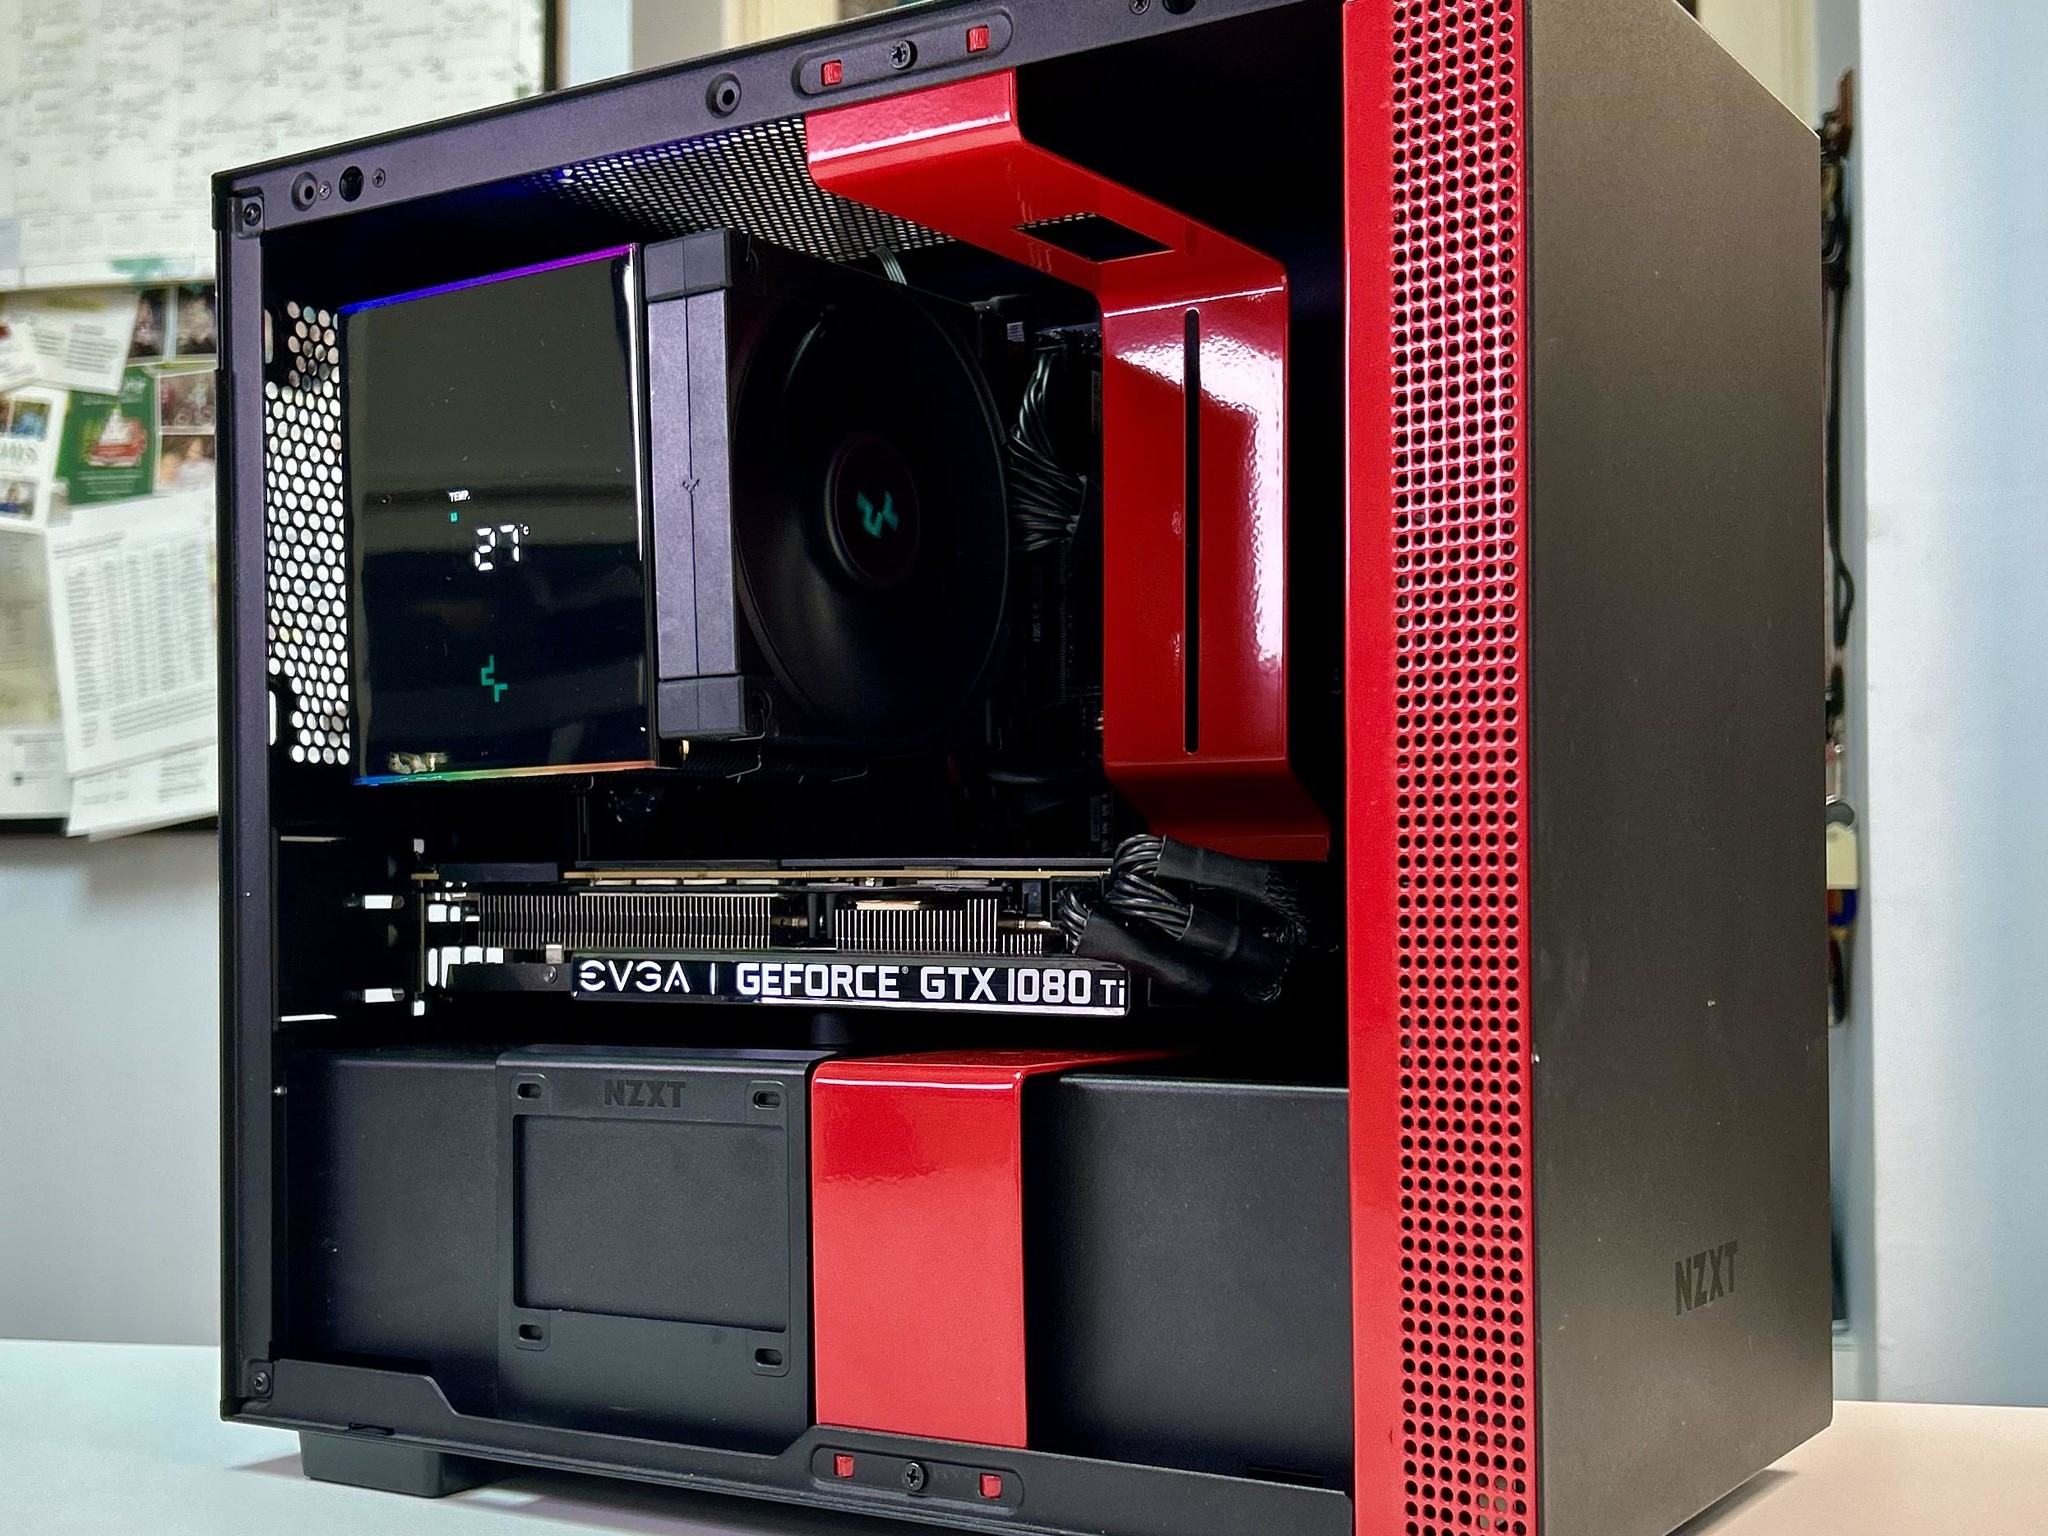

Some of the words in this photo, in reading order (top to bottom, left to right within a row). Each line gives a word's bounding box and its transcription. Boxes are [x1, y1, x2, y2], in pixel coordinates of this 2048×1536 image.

[579, 960, 690, 993] EVGA
[919, 966, 997, 1001] GTX
[1007, 968, 1092, 1004] 1080
[1099, 979, 1126, 1006] Ti
[603, 1079, 687, 1109] NZXT
[1674, 1240, 1739, 1317] NZXT
